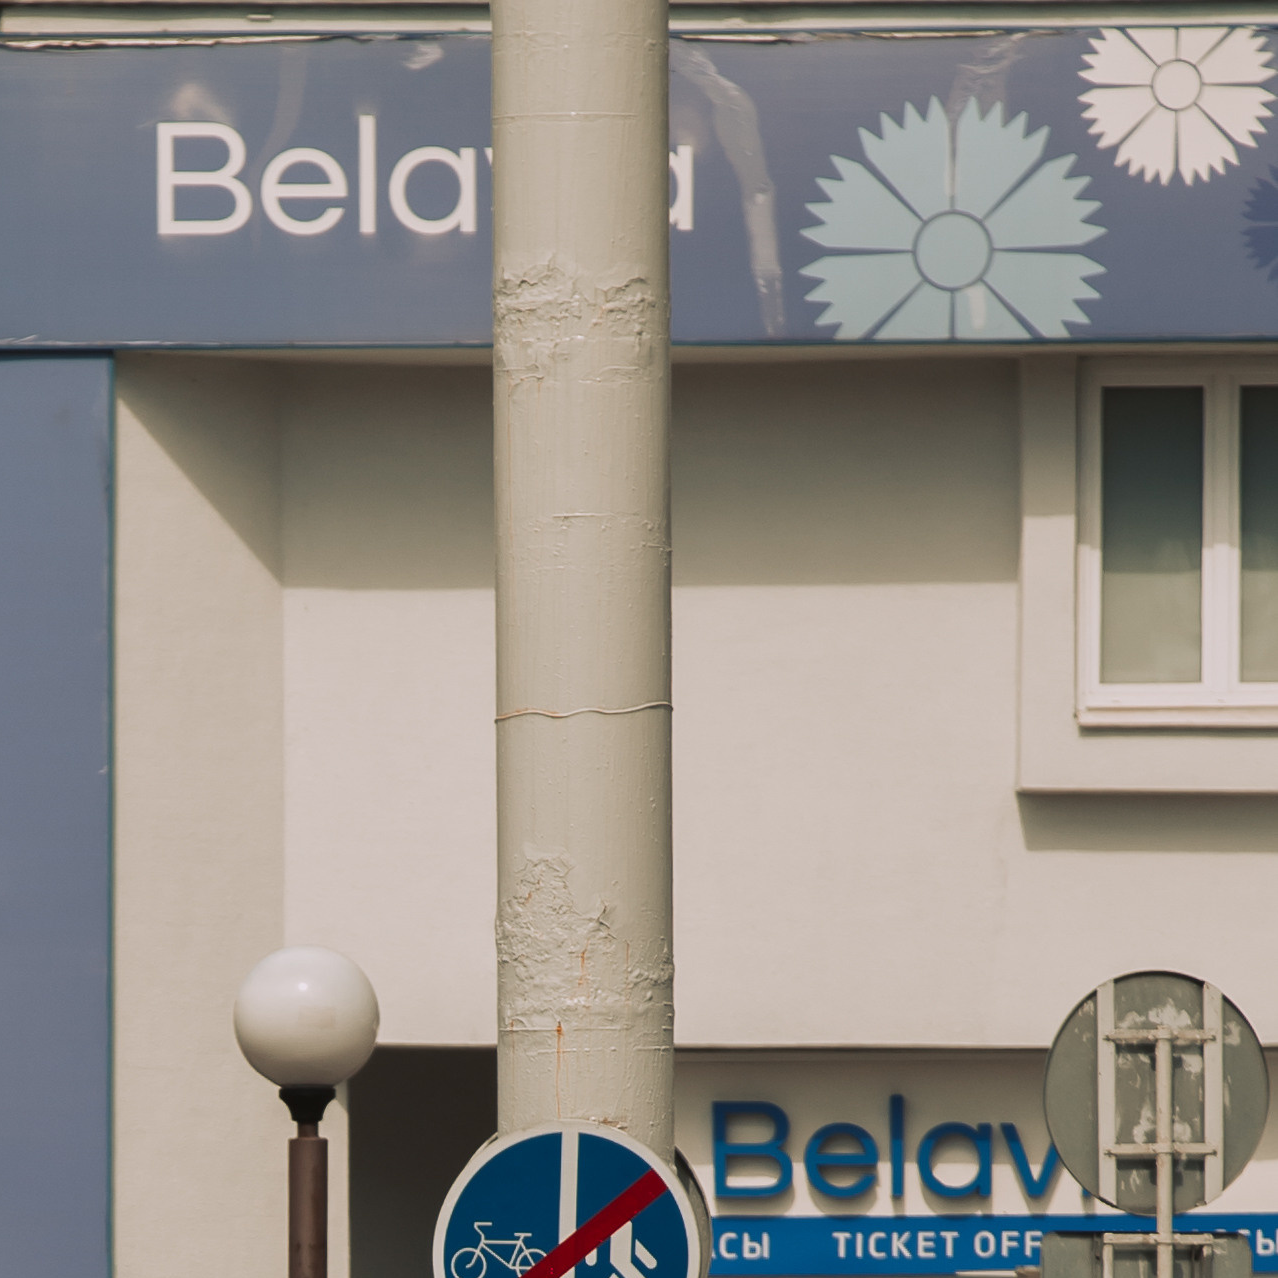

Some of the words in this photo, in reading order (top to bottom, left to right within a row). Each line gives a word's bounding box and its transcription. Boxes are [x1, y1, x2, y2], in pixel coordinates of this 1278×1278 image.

[156, 113, 694, 236] Bela
[712, 1094, 1094, 1198] Belav
[711, 1231, 770, 1259] СЫ
[832, 1231, 960, 1259] TICKET
[974, 1230, 1042, 1259] OFF
